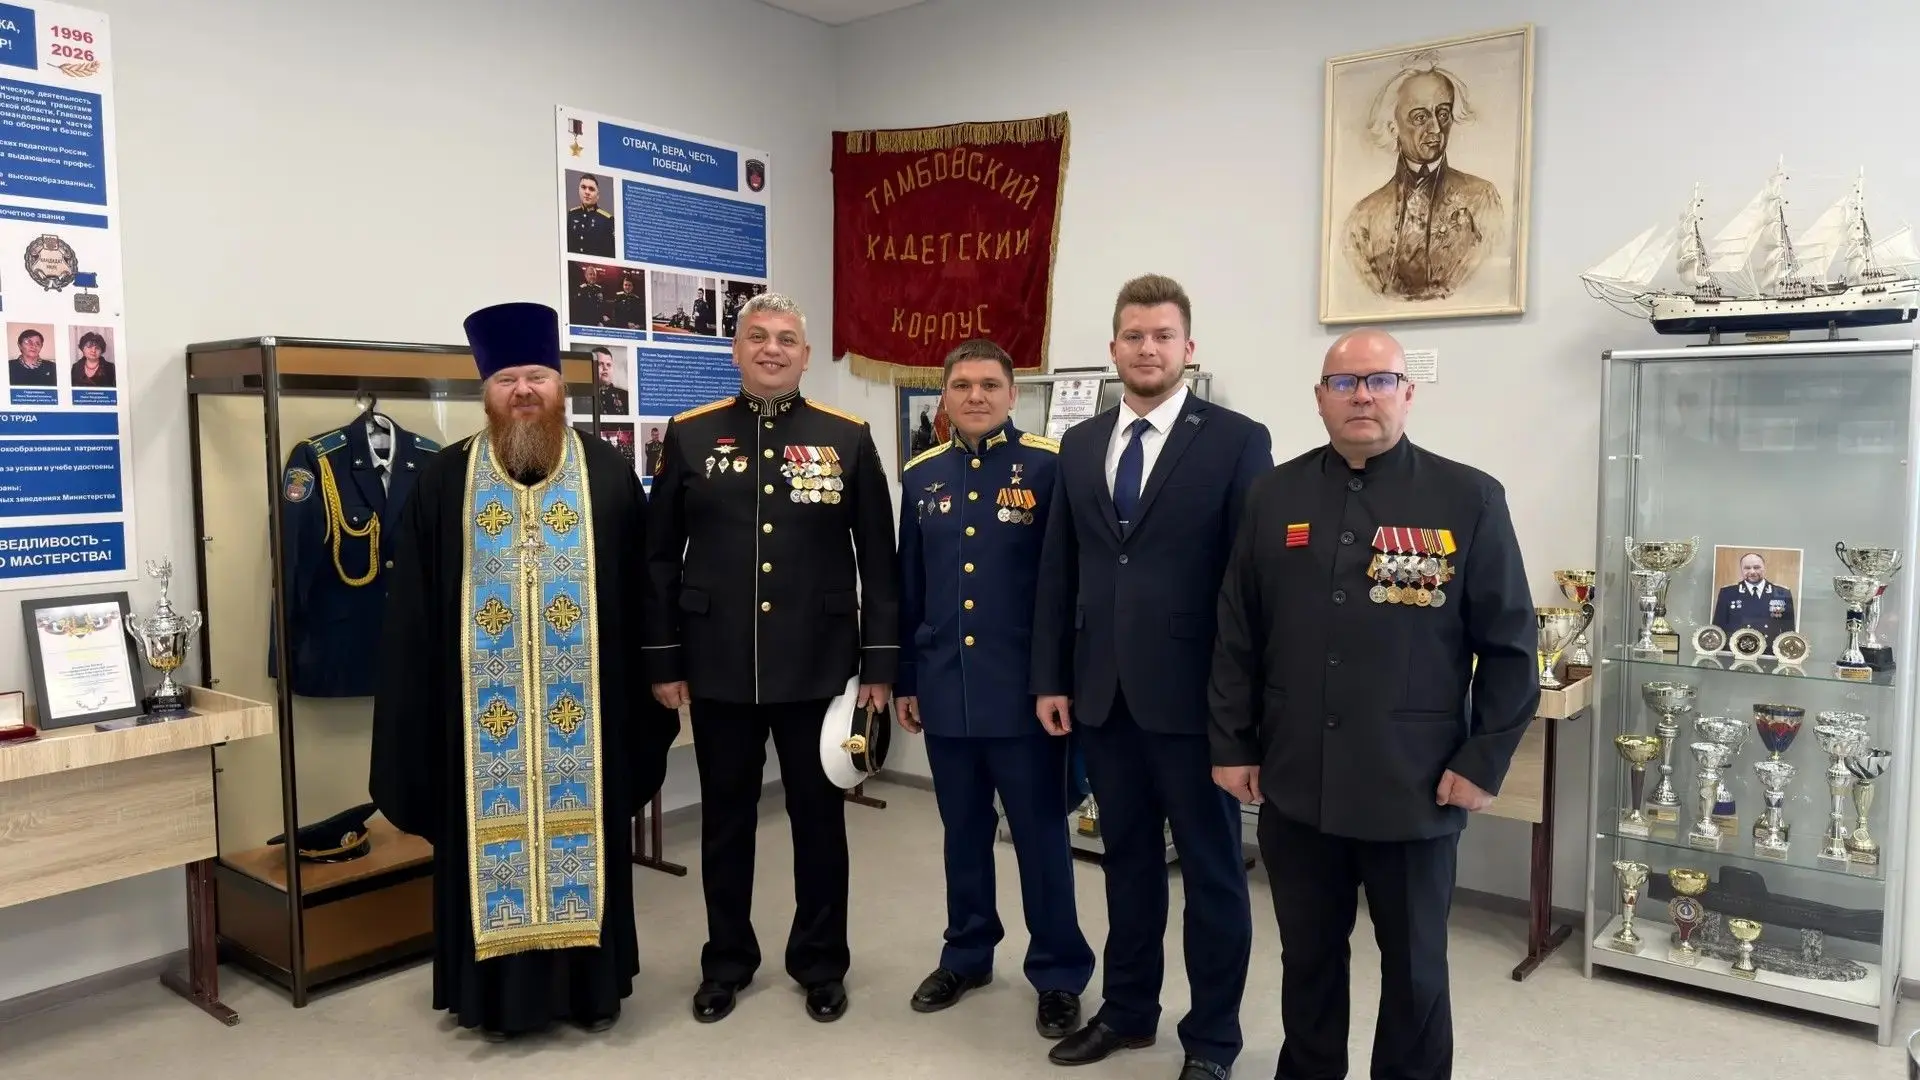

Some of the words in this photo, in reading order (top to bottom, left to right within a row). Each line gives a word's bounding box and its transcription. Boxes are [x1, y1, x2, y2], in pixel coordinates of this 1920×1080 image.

[51, 25, 93, 44] 1996
[51, 43, 94, 62] 2026
[622, 136, 660, 154] ОТВАГА,
[662, 144, 687, 160] ВЕРА,
[688, 149, 718, 167] ЧЕСТЬ,
[652, 157, 692, 174] ПОБЕДА!
[865, 147, 1041, 214] ТАМБОВСКИЙ
[36, 212, 66, 221] звание
[891, 303, 991, 346] КОРПУС
[0, 414, 9, 422] О
[10, 414, 38, 423] ТРУДА
[0, 535, 99, 552] ВЕДЛИВОСТЬ
[10, 550, 112, 567] МАСТЕРСТВА!
